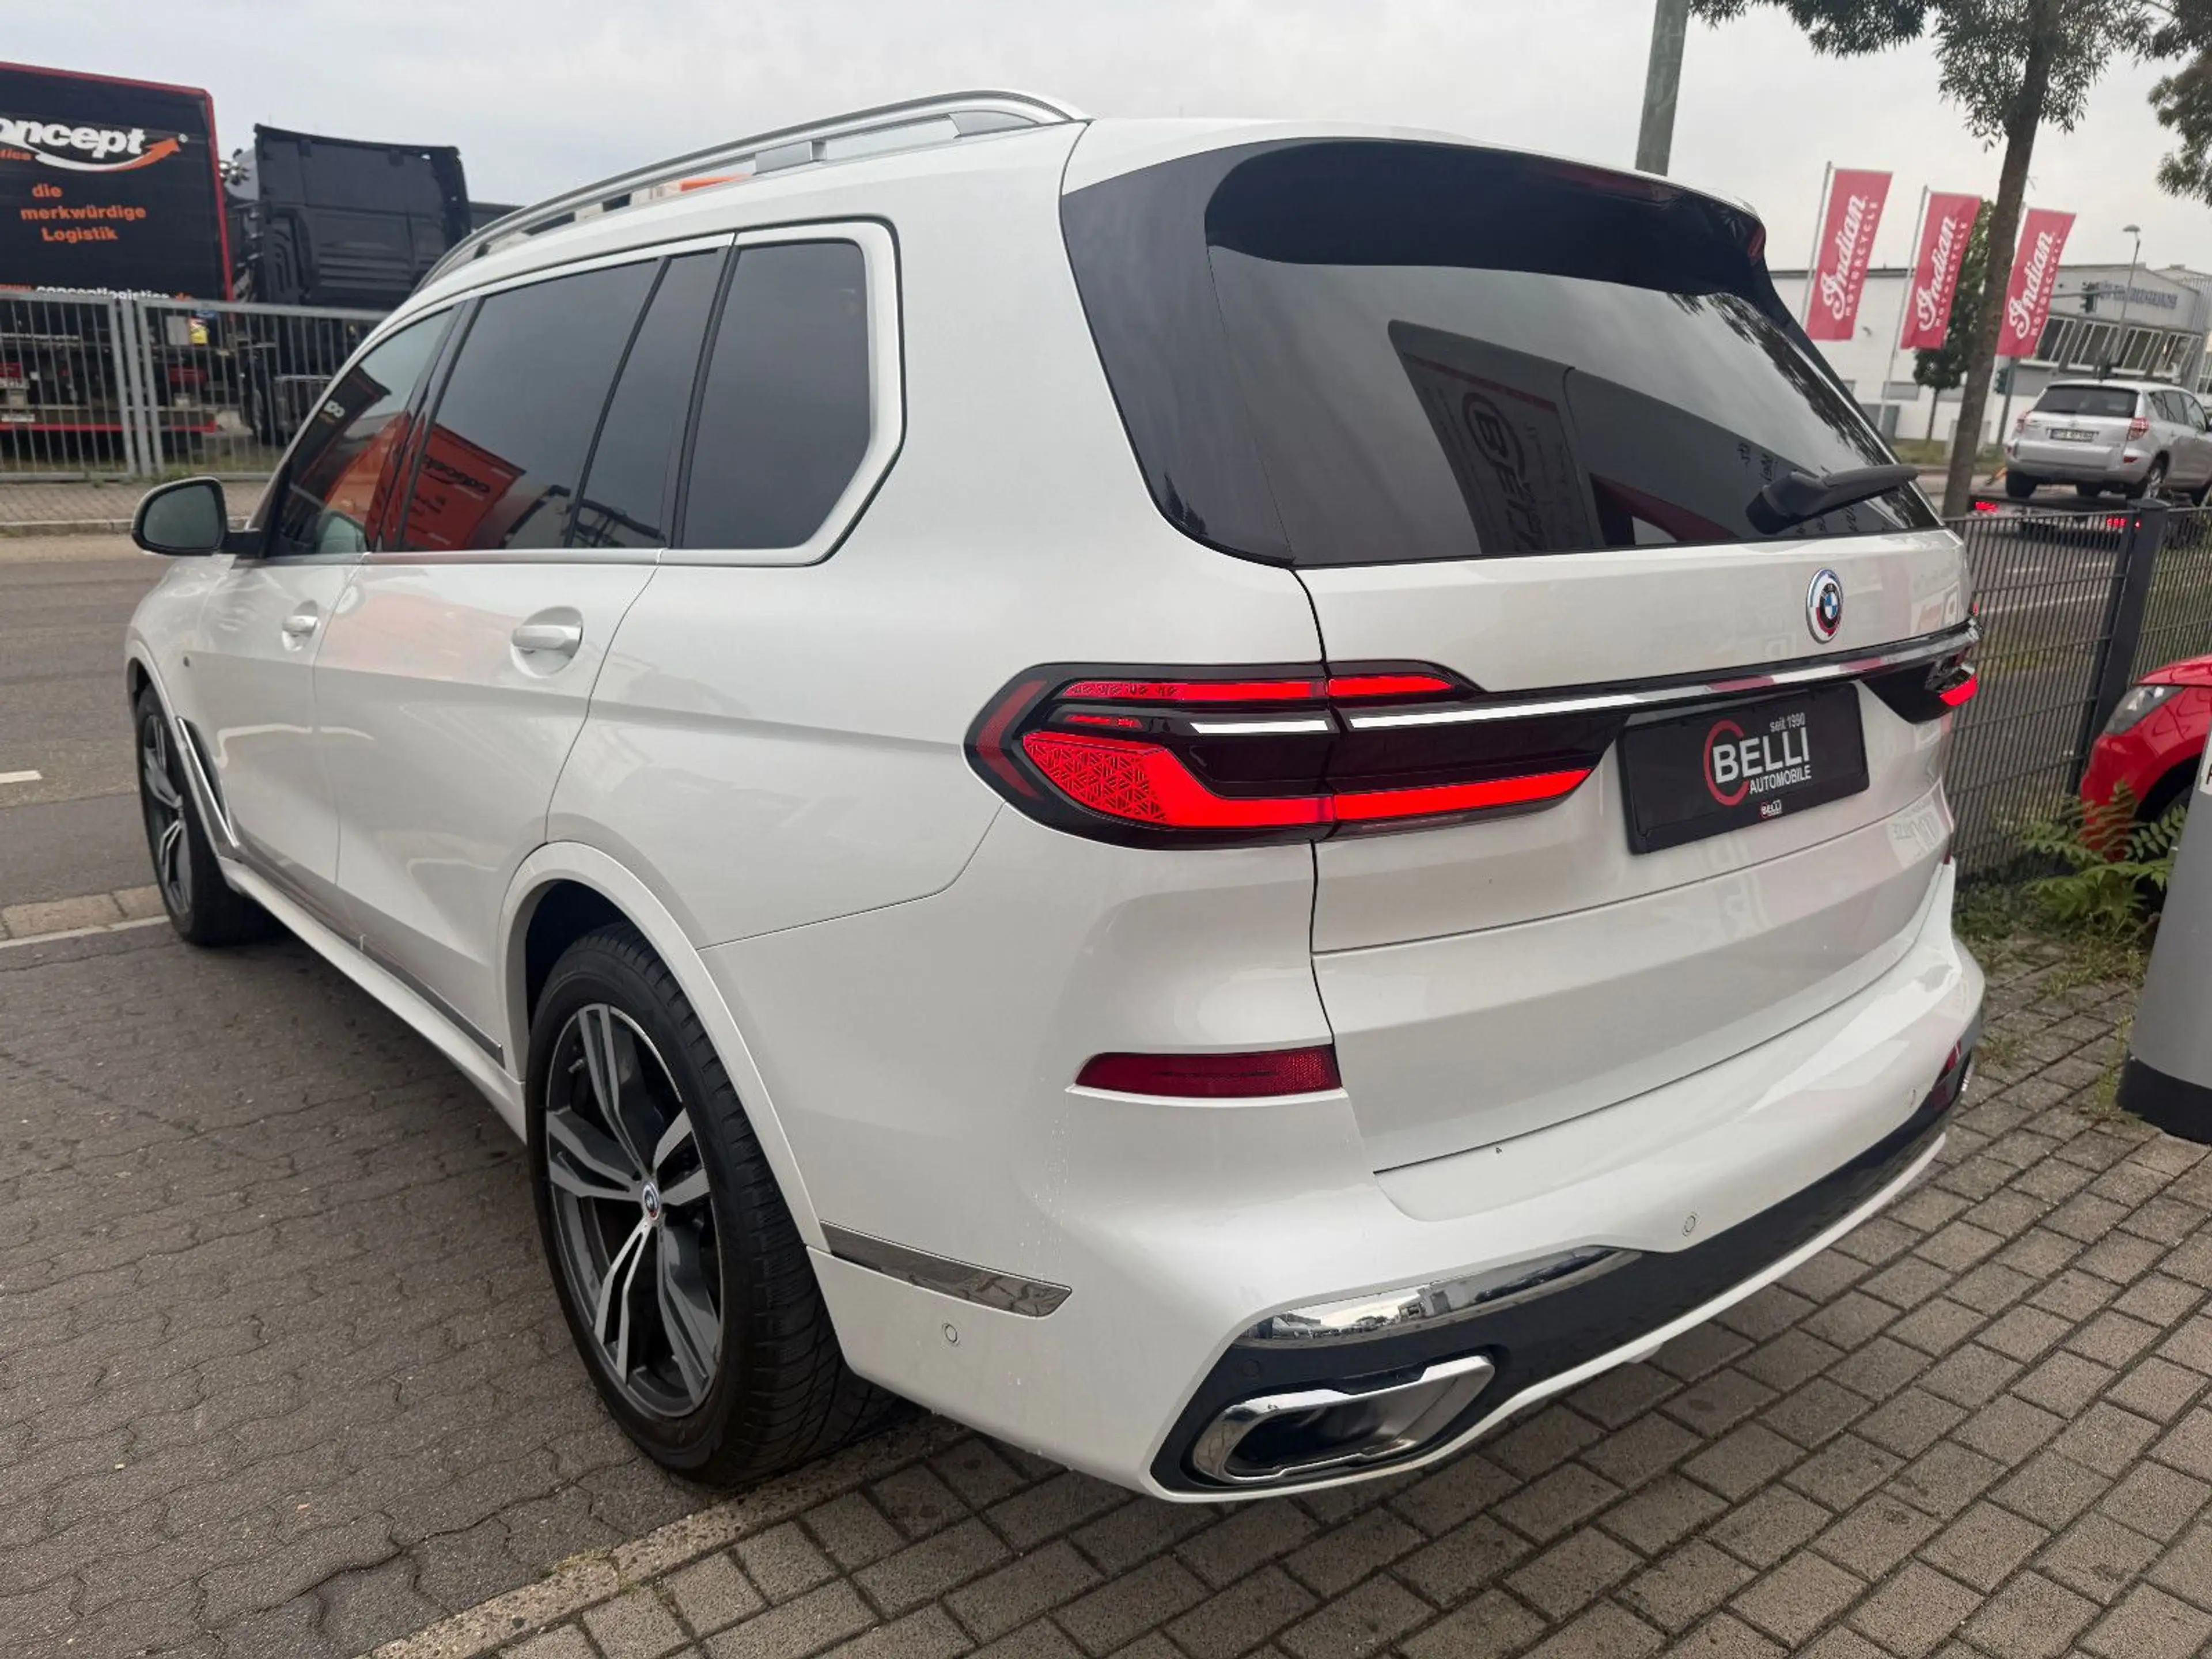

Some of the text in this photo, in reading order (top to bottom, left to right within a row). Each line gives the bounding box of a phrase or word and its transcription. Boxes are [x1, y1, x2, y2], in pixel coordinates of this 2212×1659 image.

[32, 184, 63, 197] die
[21, 204, 146, 221] merkwürdige
[41, 226, 119, 244] Logistik
[1820, 195, 1866, 320] Indian
[1845, 202, 1878, 316] MOTORCYCLE
[1916, 216, 1956, 331] Indian
[2008, 232, 2053, 339] Indian
[1770, 717, 1786, 732] seit
[1713, 727, 1810, 783] BELLI
[1749, 765, 1812, 795] AUTOMOBILE
